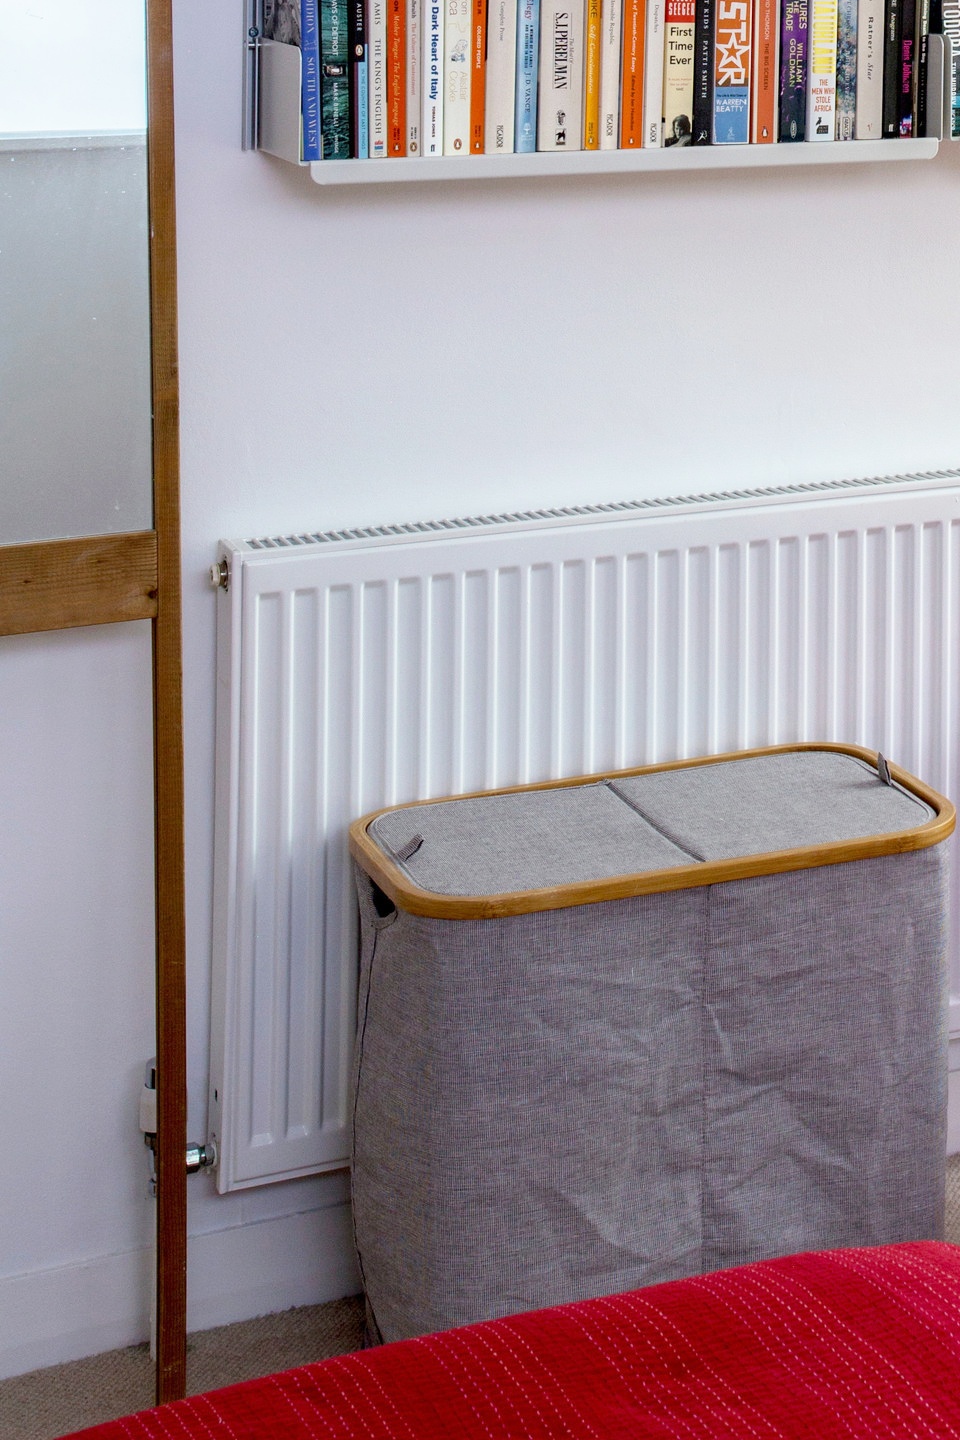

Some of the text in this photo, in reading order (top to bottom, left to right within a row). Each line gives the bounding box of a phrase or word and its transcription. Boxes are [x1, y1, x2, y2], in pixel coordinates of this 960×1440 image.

[431, 6, 439, 30] Dark
[785, 2, 794, 31] TRADE
[670, 27, 692, 36] First
[431, 34, 439, 62] Heart
[669, 41, 693, 50] Time
[669, 56, 691, 65] Ever
[431, 65, 439, 76] of
[429, 78, 439, 100] Italy
